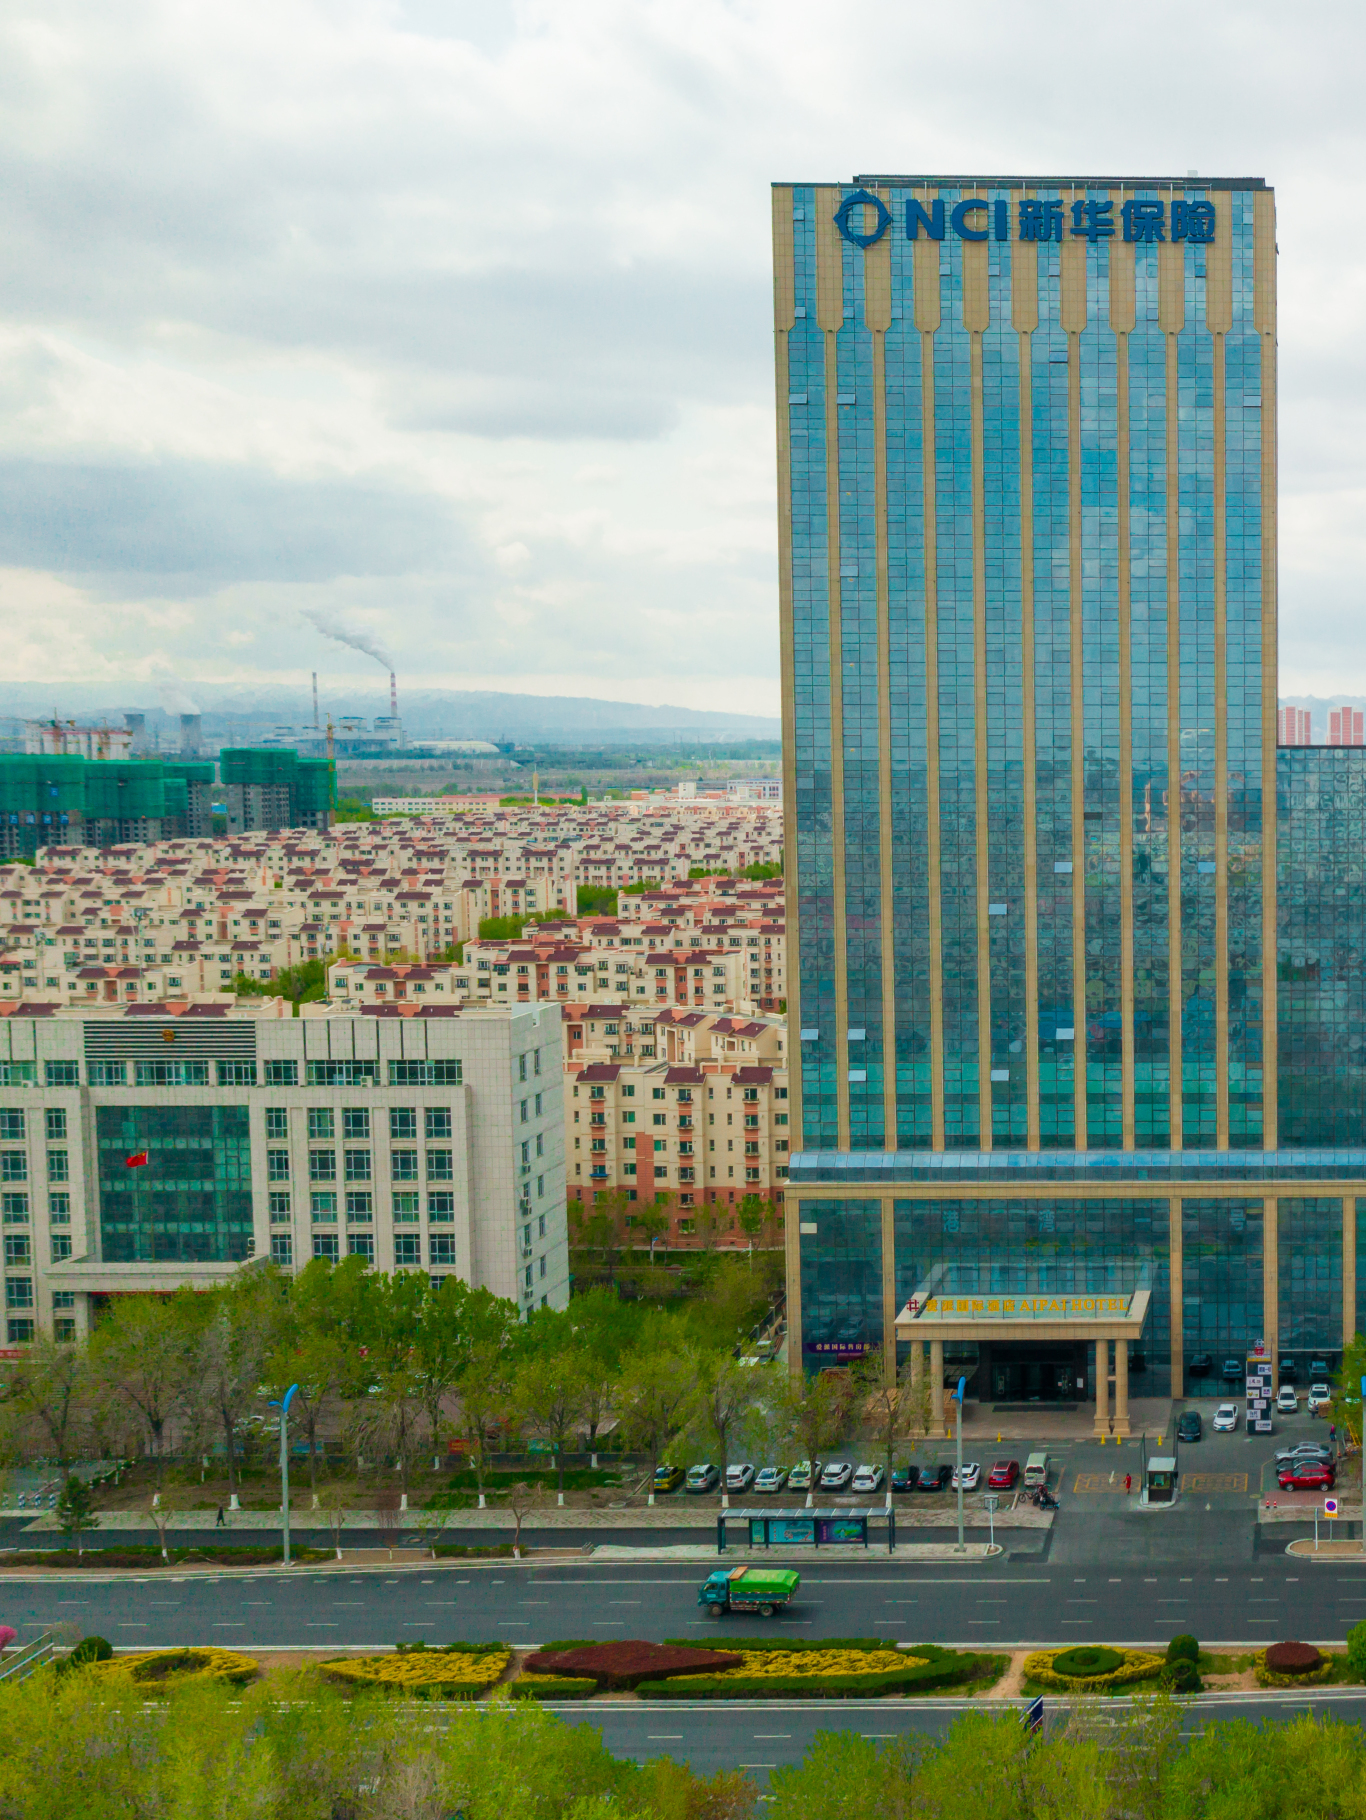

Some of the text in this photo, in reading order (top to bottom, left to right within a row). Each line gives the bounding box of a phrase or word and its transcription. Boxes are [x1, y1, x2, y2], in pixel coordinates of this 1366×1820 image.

[905, 198, 1216, 243] NCI 新华保险
[925, 1298, 1129, 1312] 爱派国际酒店 AIPAI HOTEL
